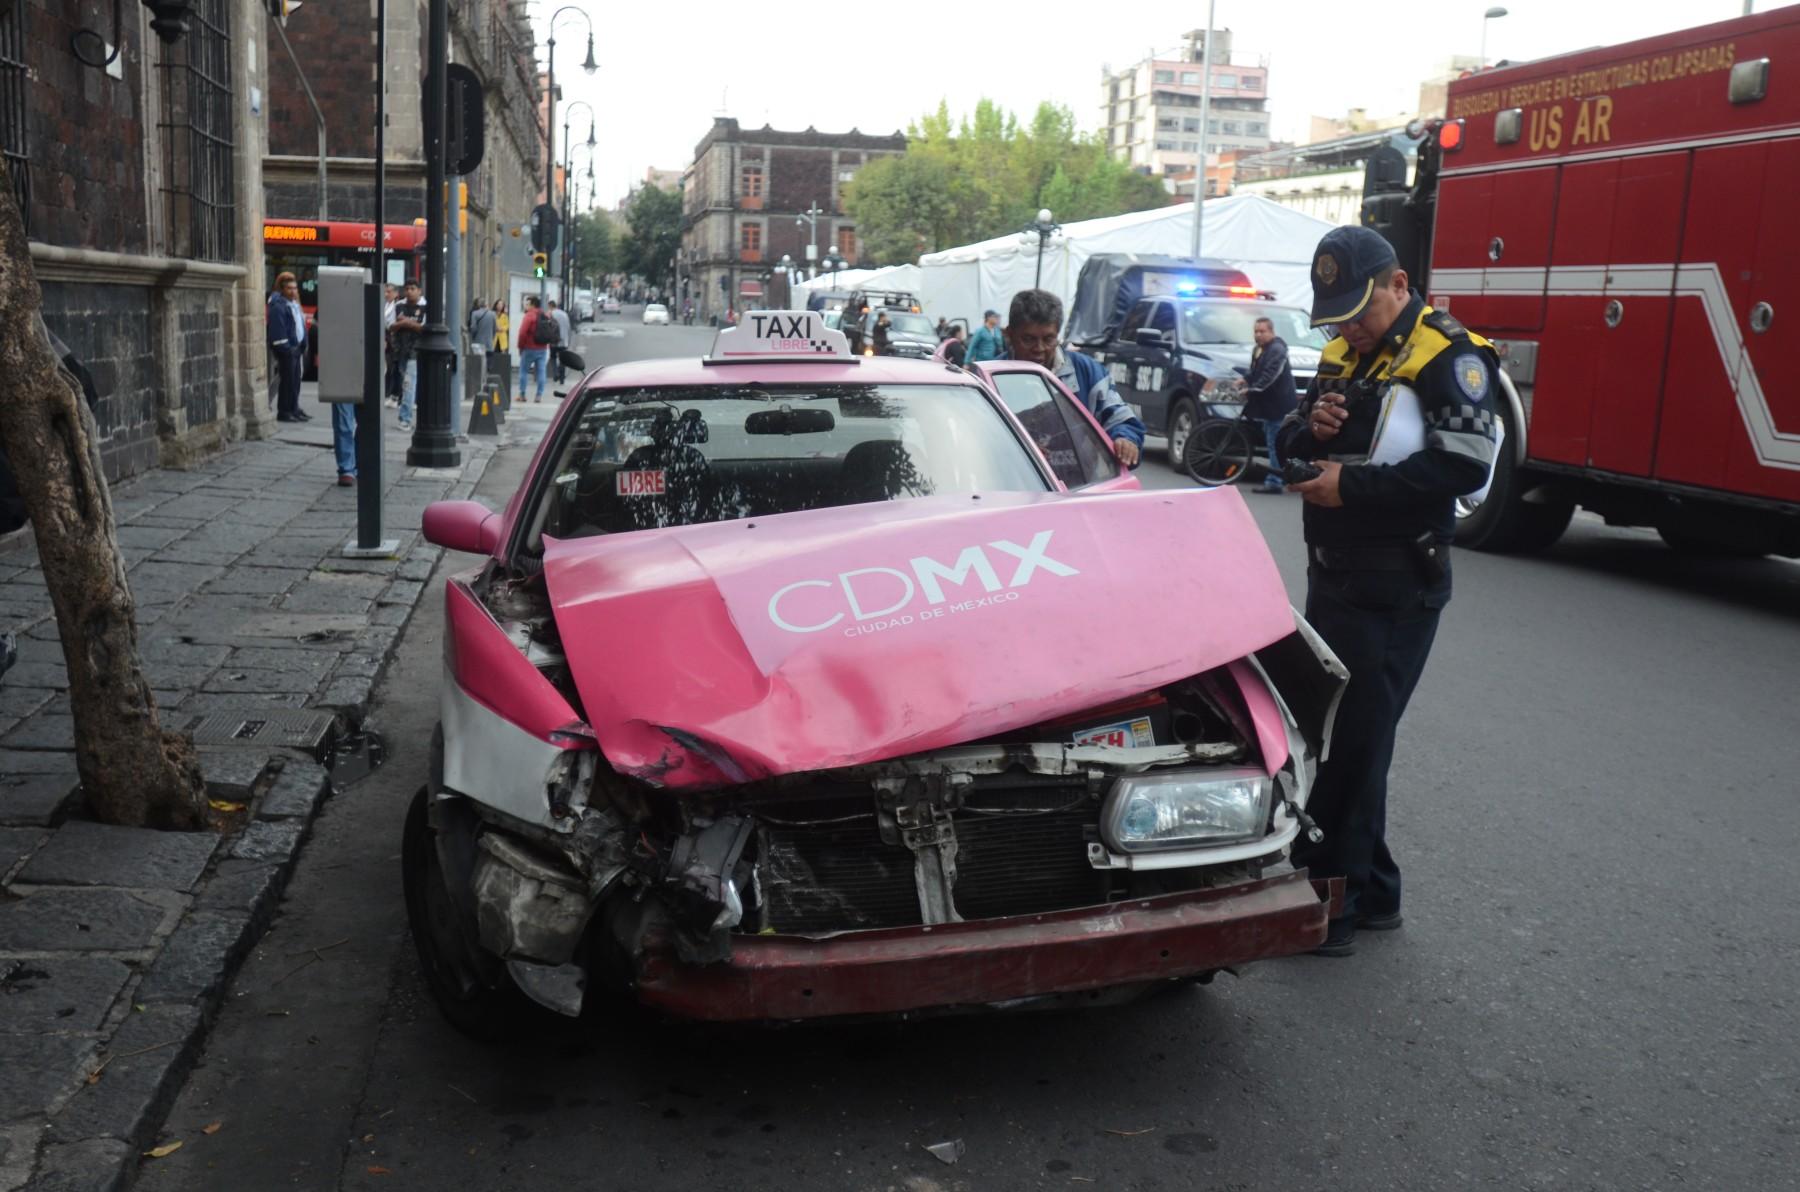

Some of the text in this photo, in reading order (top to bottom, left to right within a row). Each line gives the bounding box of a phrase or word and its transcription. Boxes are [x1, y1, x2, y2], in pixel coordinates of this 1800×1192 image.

[1509, 79, 1554, 107] RESCATE
[1554, 77, 1569, 100] EN
[1569, 59, 1649, 97] ESTRUCTURAS
[1650, 43, 1735, 83] COLAPSADAS
[1529, 97, 1614, 151] US AR
[361, 230, 392, 240] CDX
[752, 316, 811, 339] TAXI
[771, 339, 809, 350] LIBRE
[620, 471, 664, 494] LIBRE
[768, 529, 1081, 633] CDMX
[844, 615, 914, 637] CIUDAD
[919, 608, 945, 620] DE
